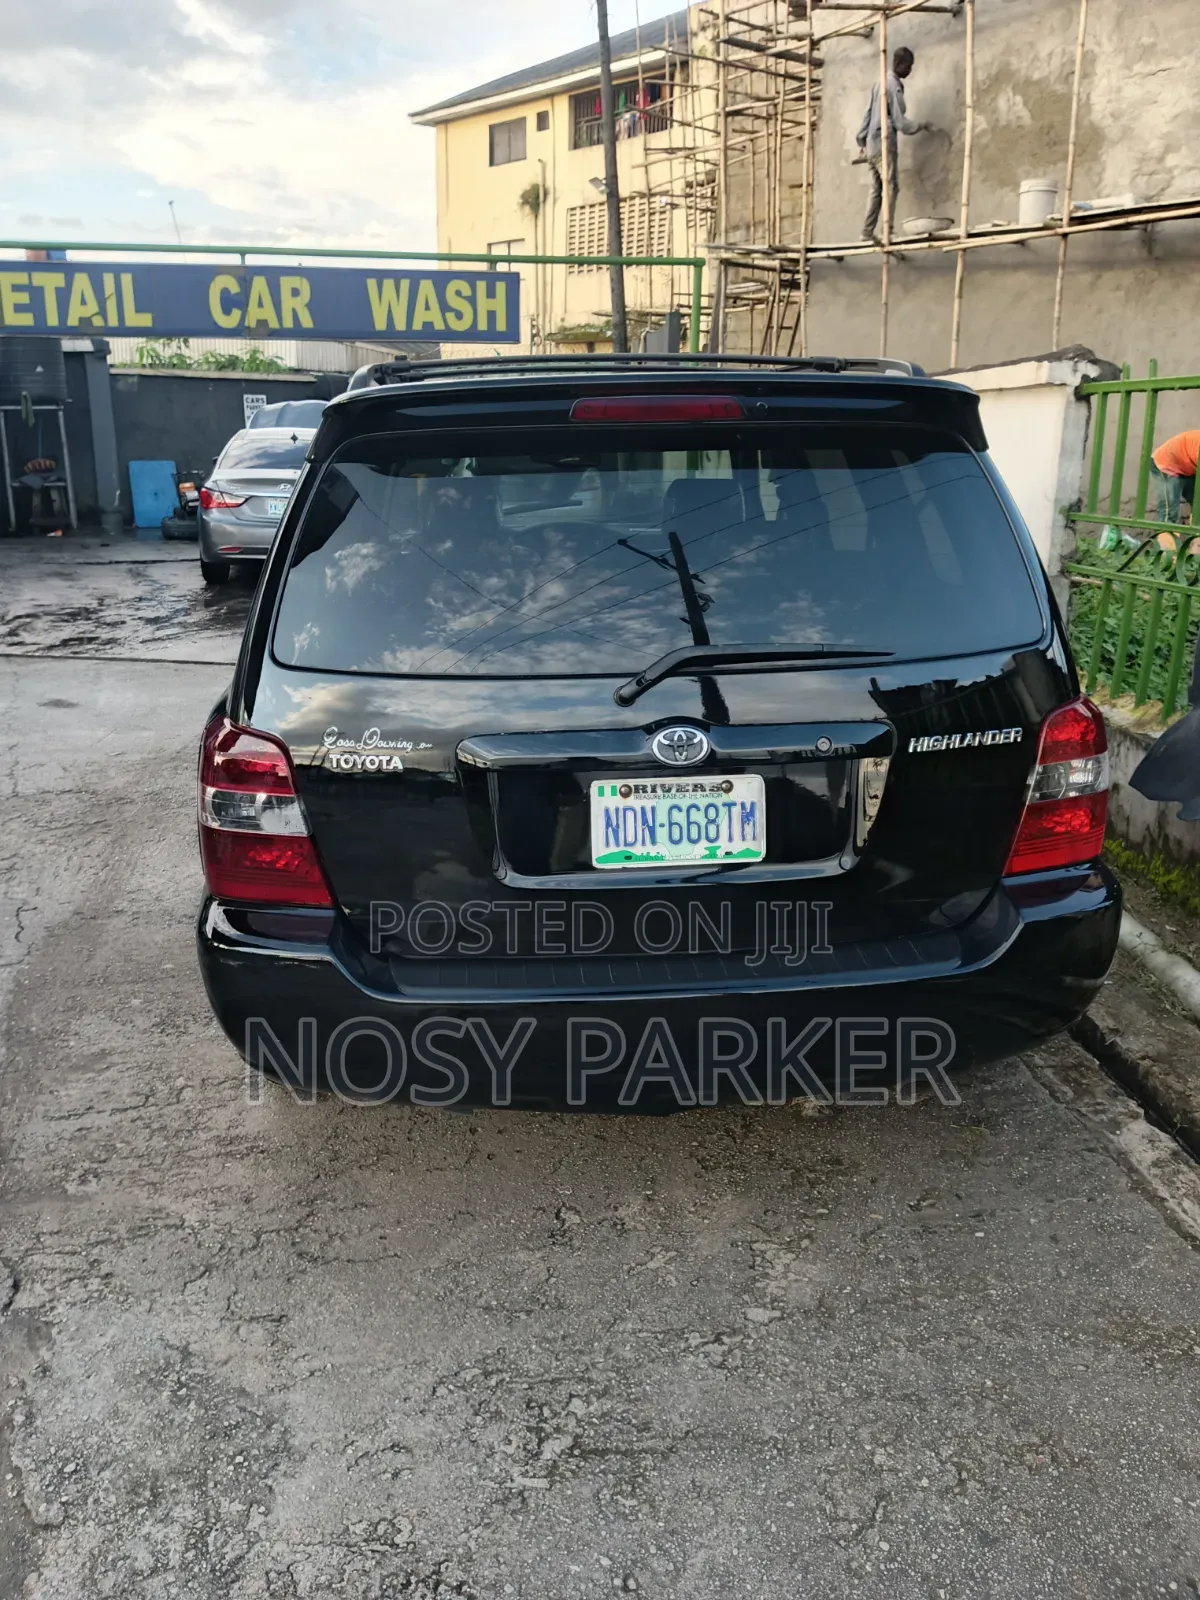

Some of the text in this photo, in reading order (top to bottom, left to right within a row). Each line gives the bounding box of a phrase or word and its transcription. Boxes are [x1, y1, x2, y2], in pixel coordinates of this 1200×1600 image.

[208, 274, 314, 330] CAR
[367, 278, 507, 332] WASH
[907, 726, 1023, 753] HIGHLANDER
[328, 754, 404, 771] TOYOTA
[633, 782, 723, 794] RIVERS
[603, 801, 757, 848] NDN-668TM
